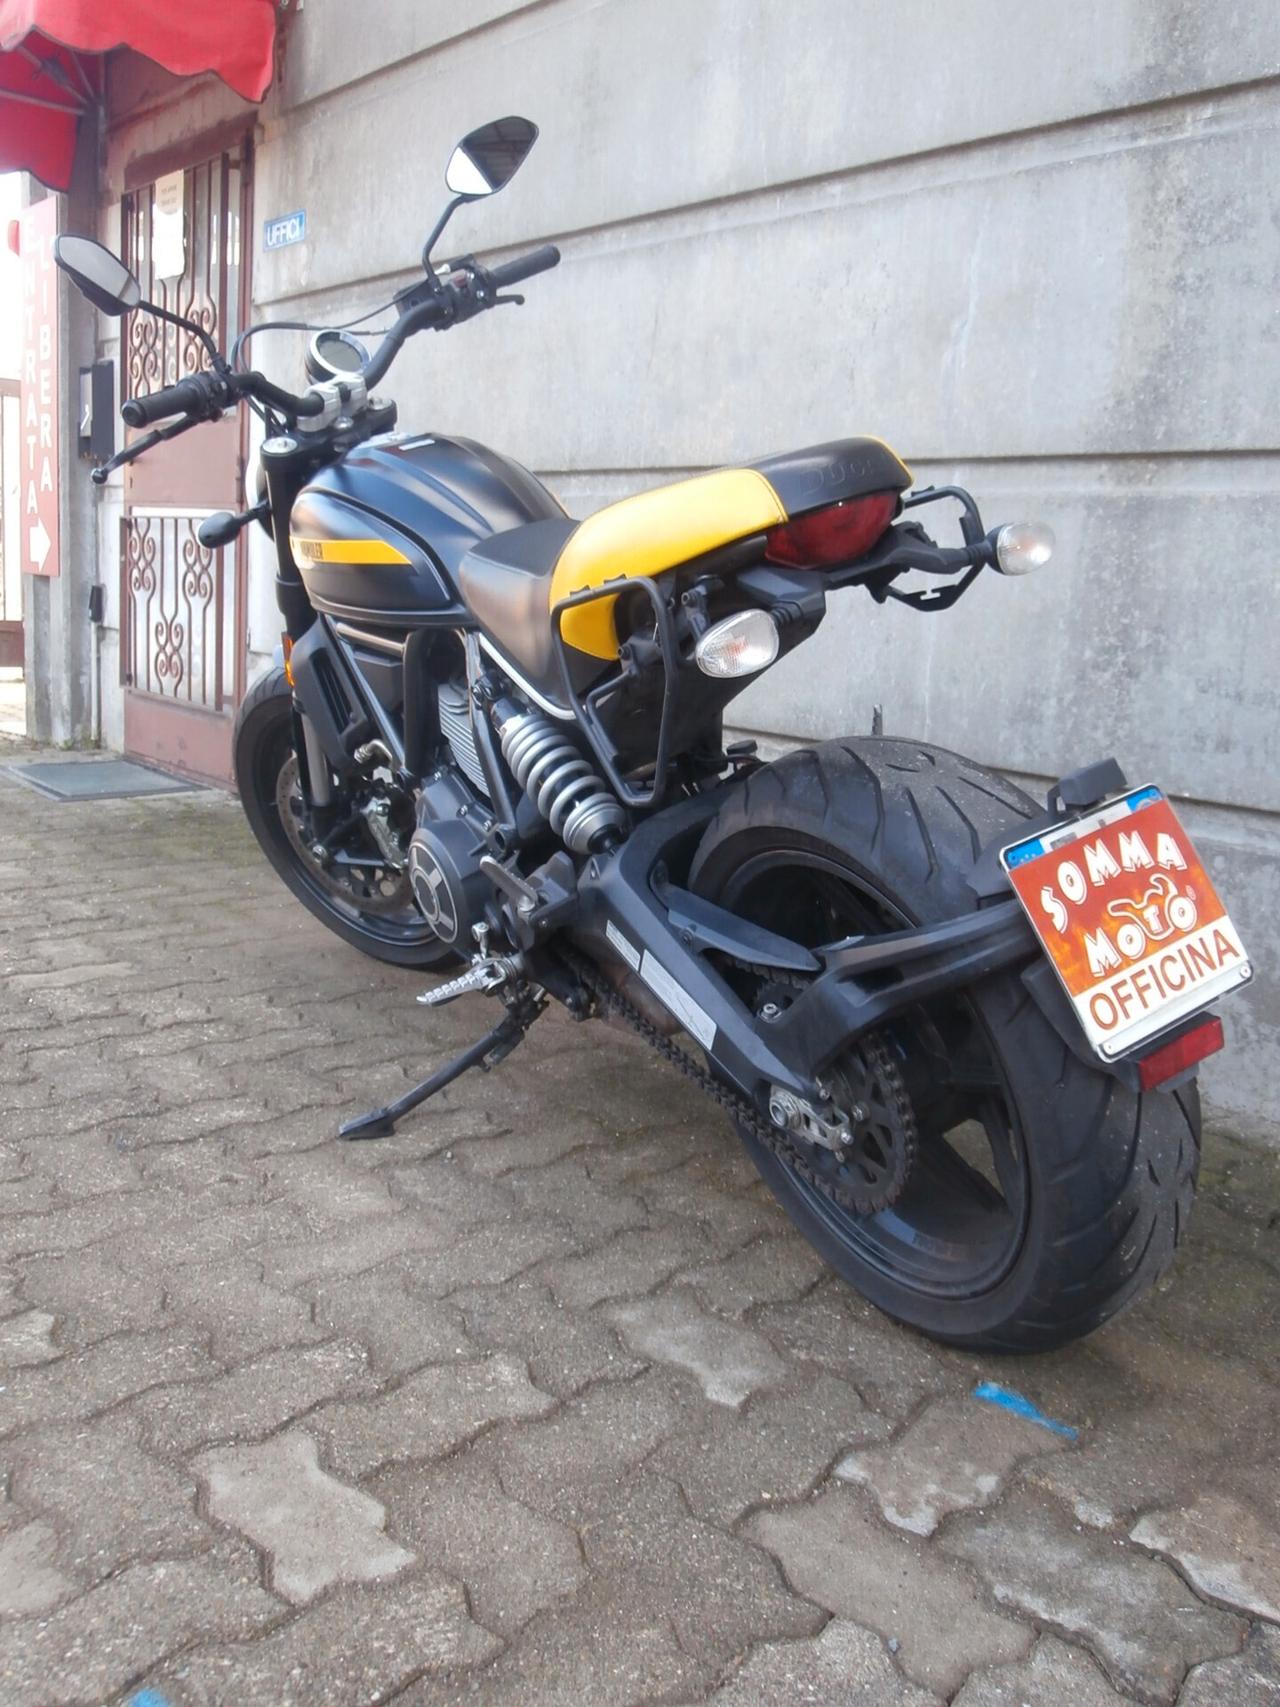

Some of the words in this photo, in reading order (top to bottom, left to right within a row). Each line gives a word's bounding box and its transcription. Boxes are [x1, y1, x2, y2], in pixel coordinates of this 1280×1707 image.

[267, 216, 300, 246] UFFICI
[23, 216, 38, 514] ENTRATA
[39, 235, 52, 492] LIBERA
[1040, 830, 1187, 934] SOMMA
[1084, 896, 1197, 977] MOTO
[1089, 929, 1240, 1031] OFFICINA
